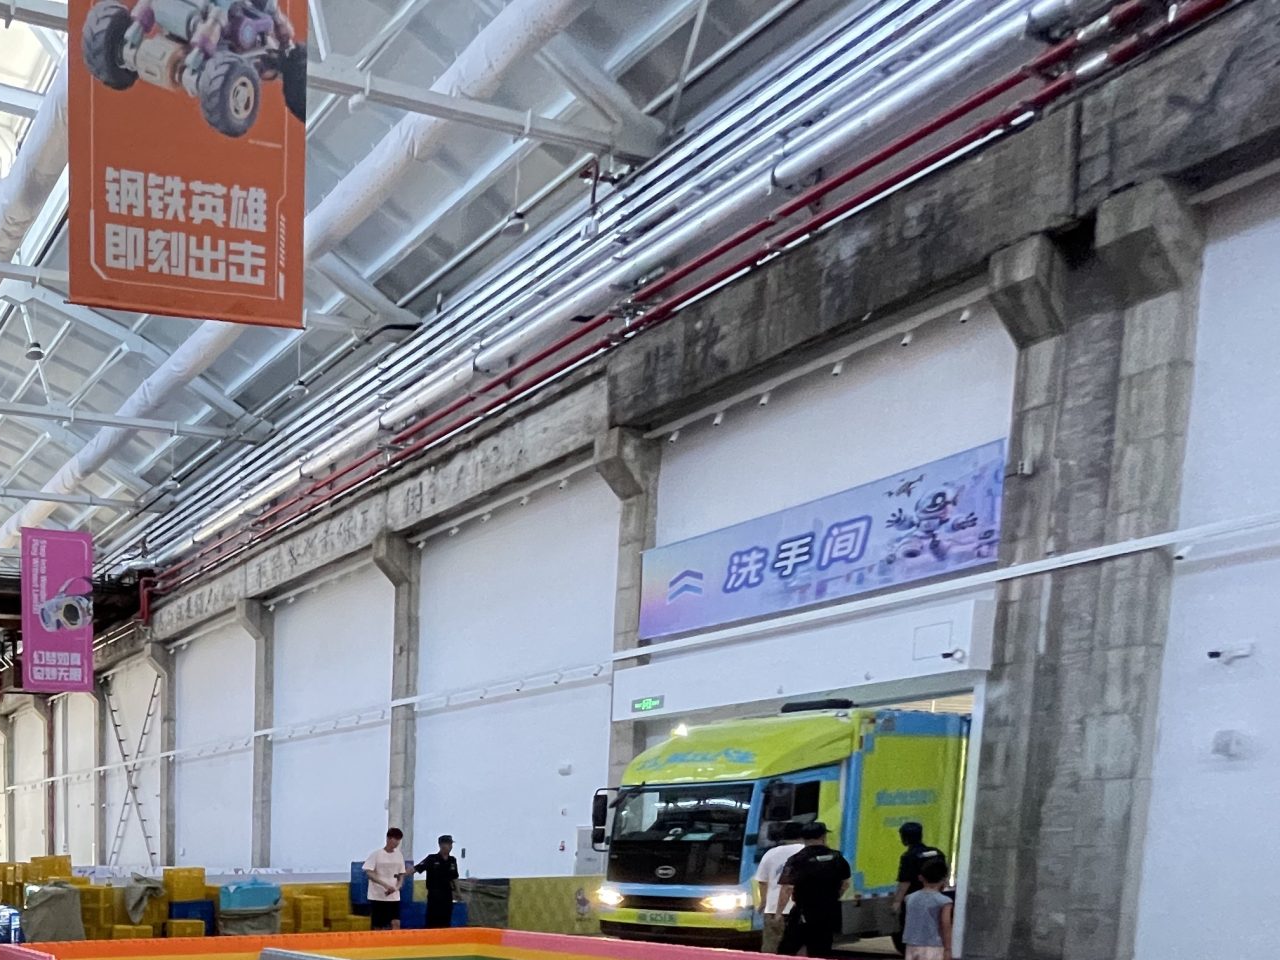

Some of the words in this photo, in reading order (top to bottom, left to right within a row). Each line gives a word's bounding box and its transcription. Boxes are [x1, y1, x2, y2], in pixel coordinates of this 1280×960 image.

[104, 166, 267, 233] 钢铁英雄
[104, 223, 267, 286] 即刻出击
[724, 516, 871, 593] 洗手间
